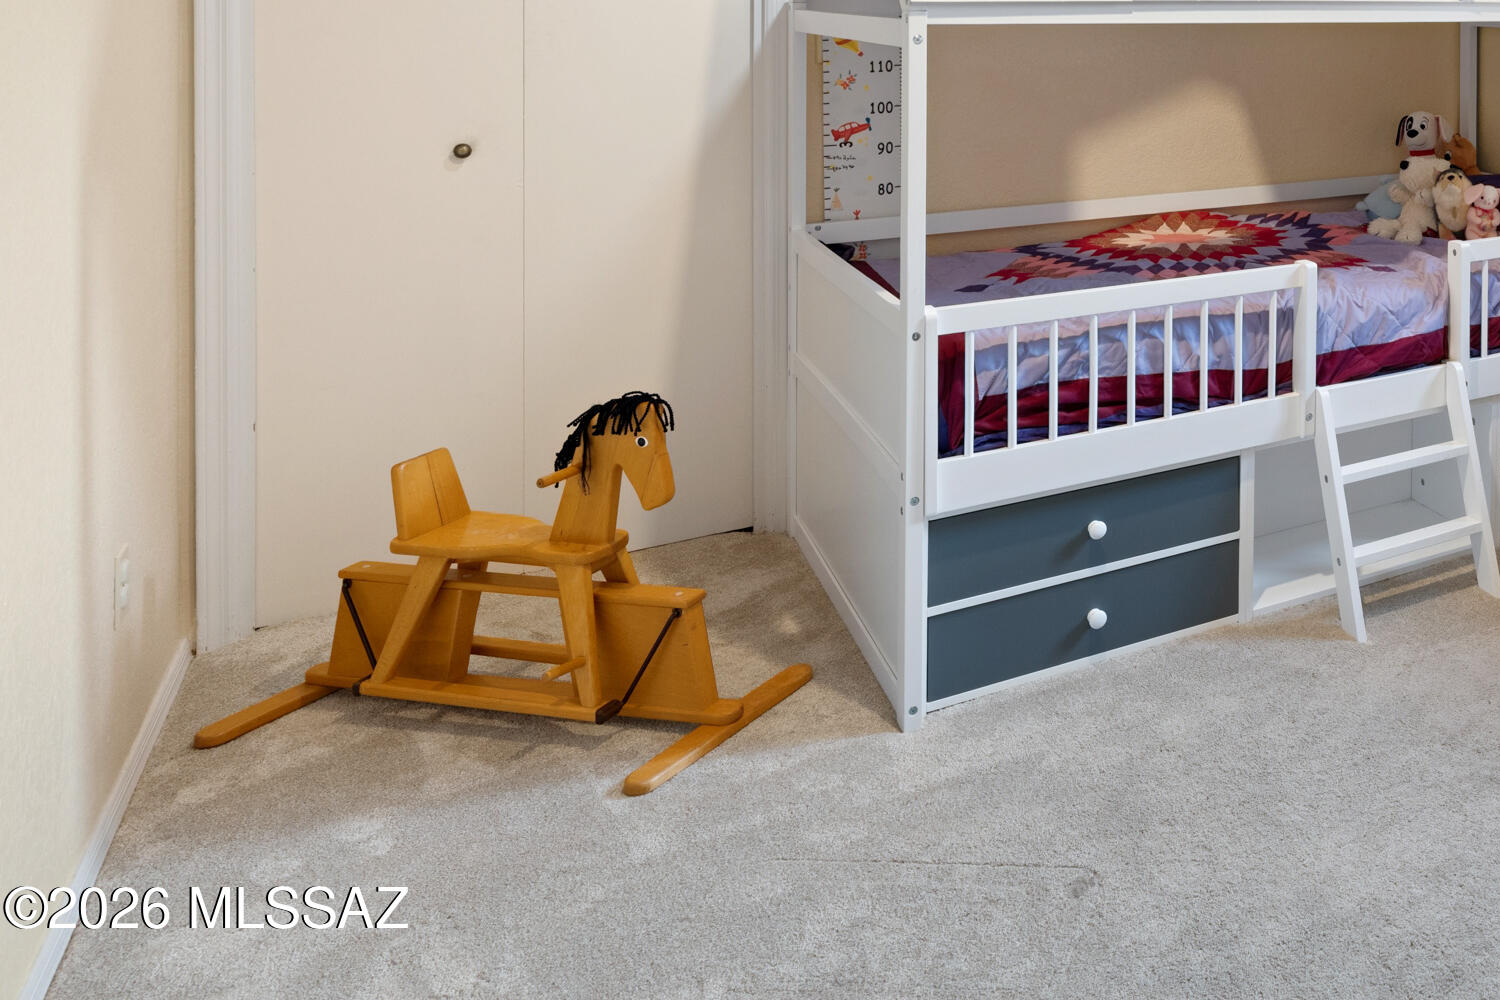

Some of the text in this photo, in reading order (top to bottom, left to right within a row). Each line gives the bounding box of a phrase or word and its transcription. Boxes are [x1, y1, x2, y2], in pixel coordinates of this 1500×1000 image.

[870, 60, 893, 73] 110
[870, 101, 893, 114] 100
[878, 141, 894, 155] 90
[878, 182, 894, 196] 80
